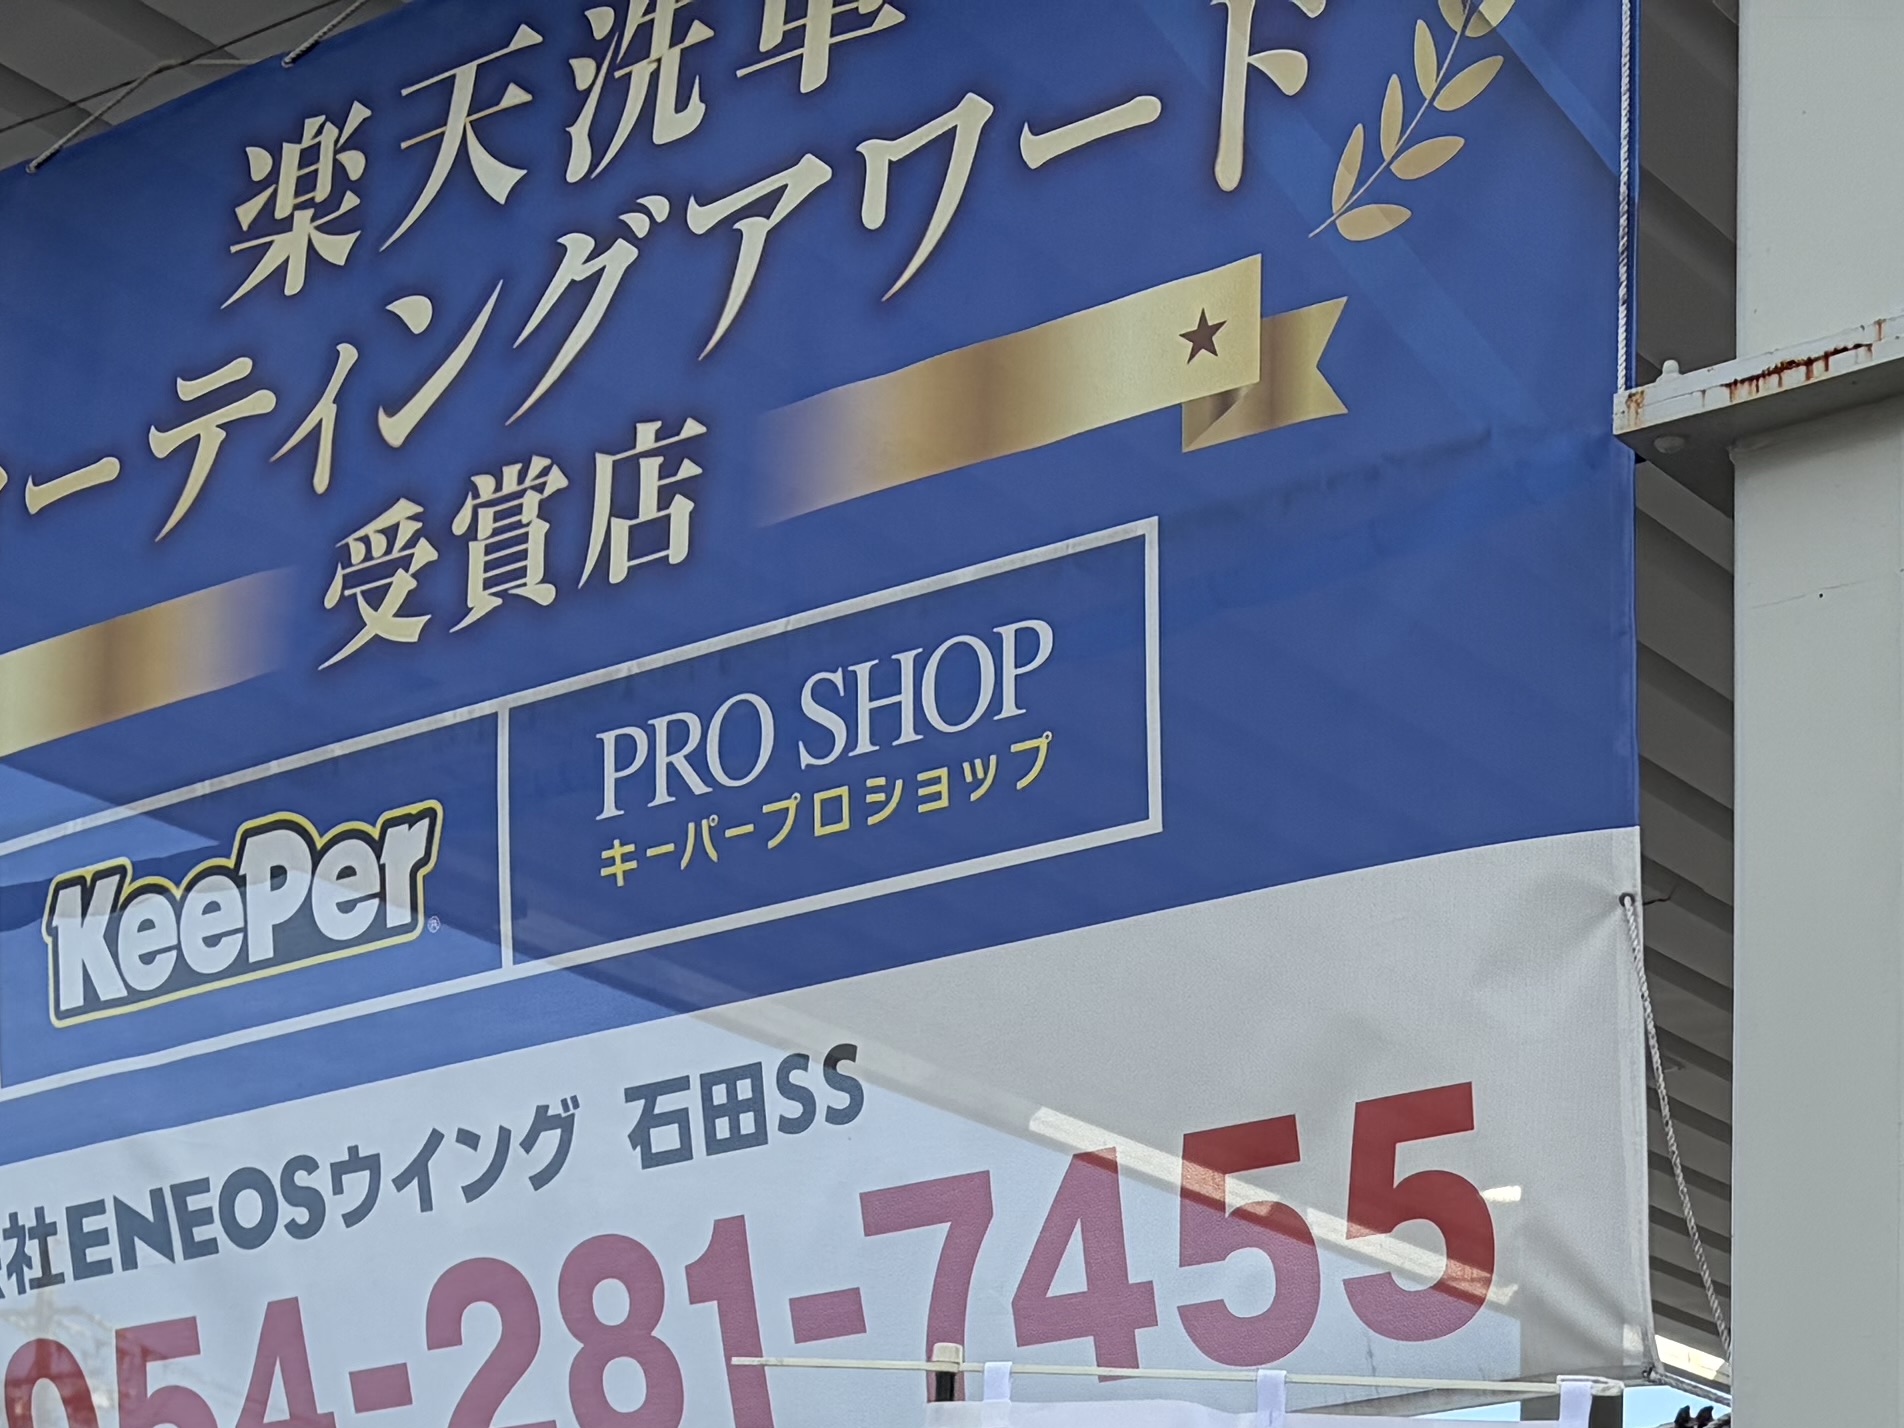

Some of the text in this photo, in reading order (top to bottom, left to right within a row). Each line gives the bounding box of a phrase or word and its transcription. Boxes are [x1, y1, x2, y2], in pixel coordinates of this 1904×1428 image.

[317, 412, 705, 671] 受賞店
[596, 619, 1054, 820] PRO SHOP
[600, 731, 1053, 887] キーパープロショップ
[48, 804, 440, 1020] KeePer
[624, 1042, 864, 1171] 石田SS
